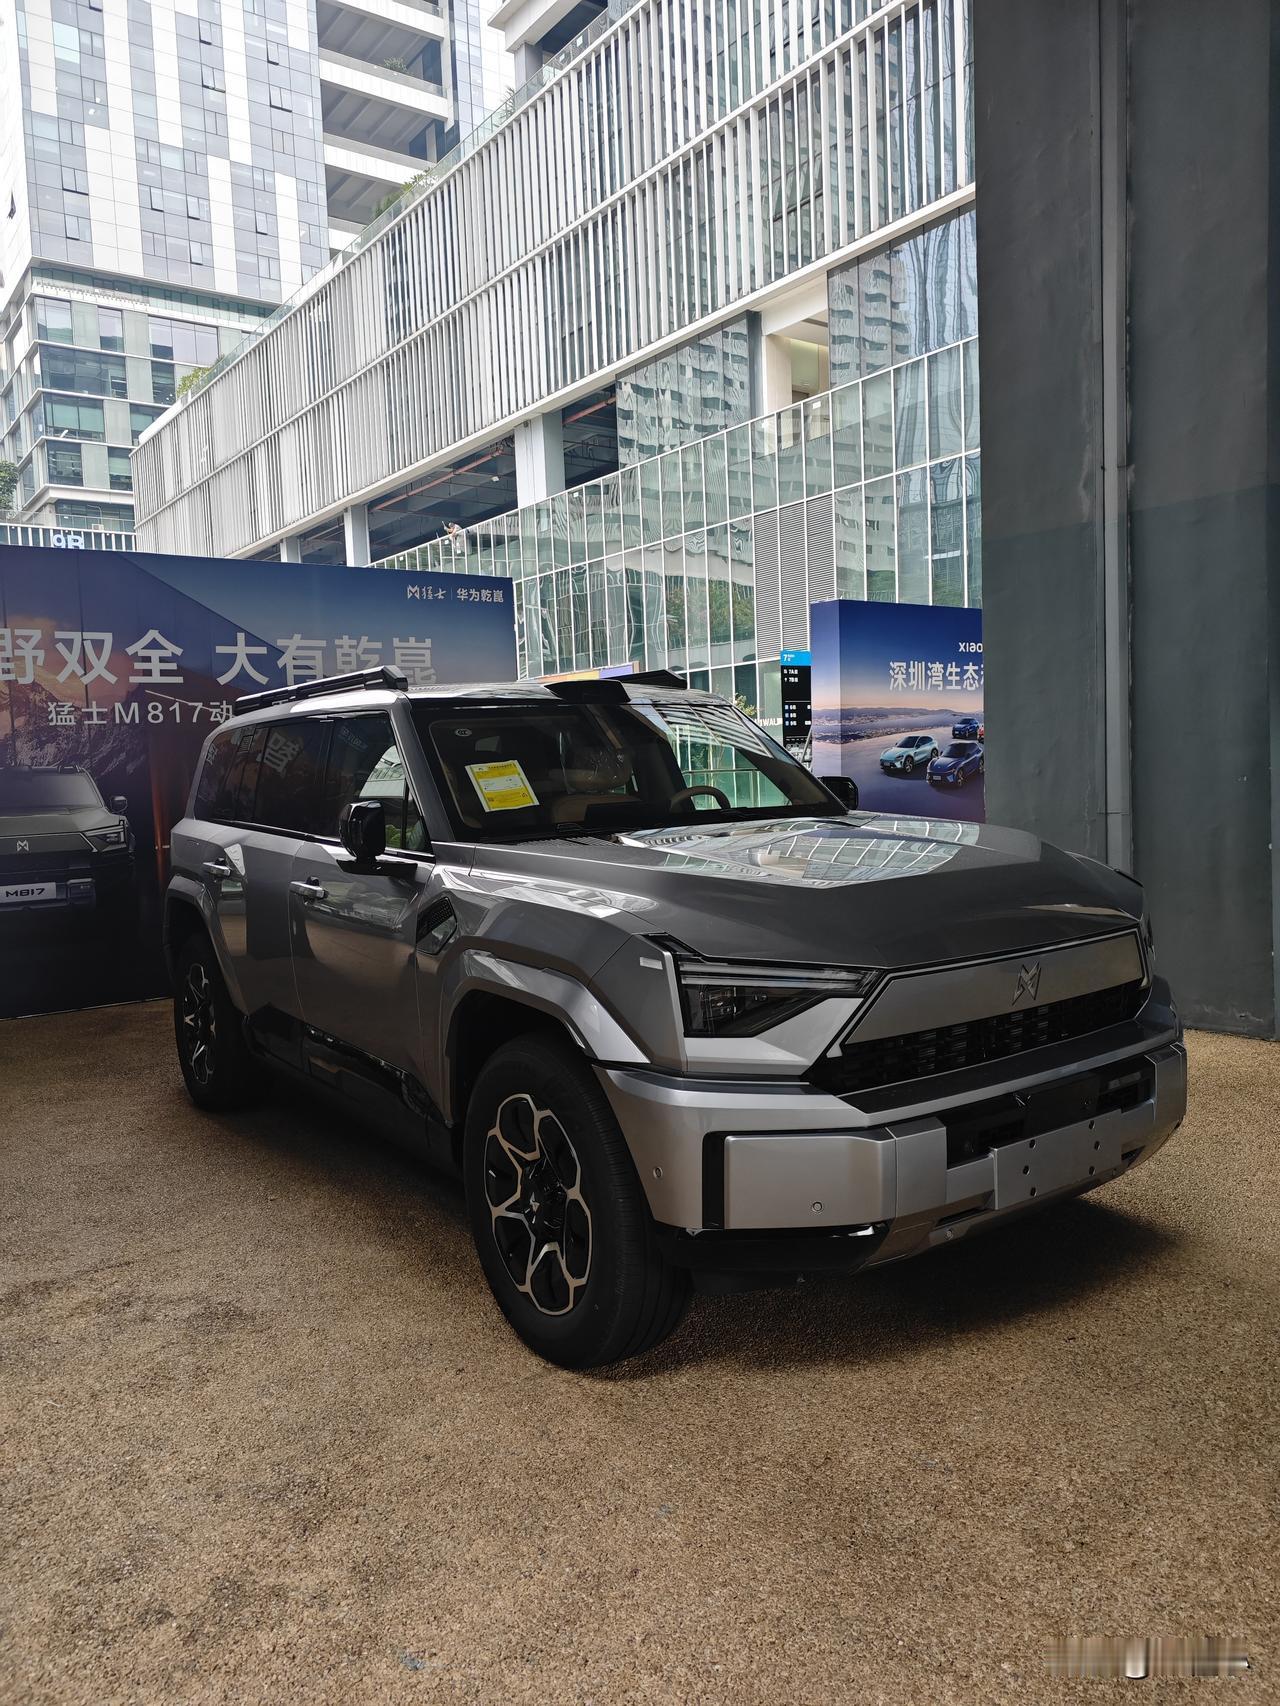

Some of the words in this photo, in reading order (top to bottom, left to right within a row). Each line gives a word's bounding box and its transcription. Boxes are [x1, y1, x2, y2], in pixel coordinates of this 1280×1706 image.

[0, 628, 184, 685] 野双全
[889, 661, 984, 691] 深圳湾生态
[5, 887, 45, 898] M817
